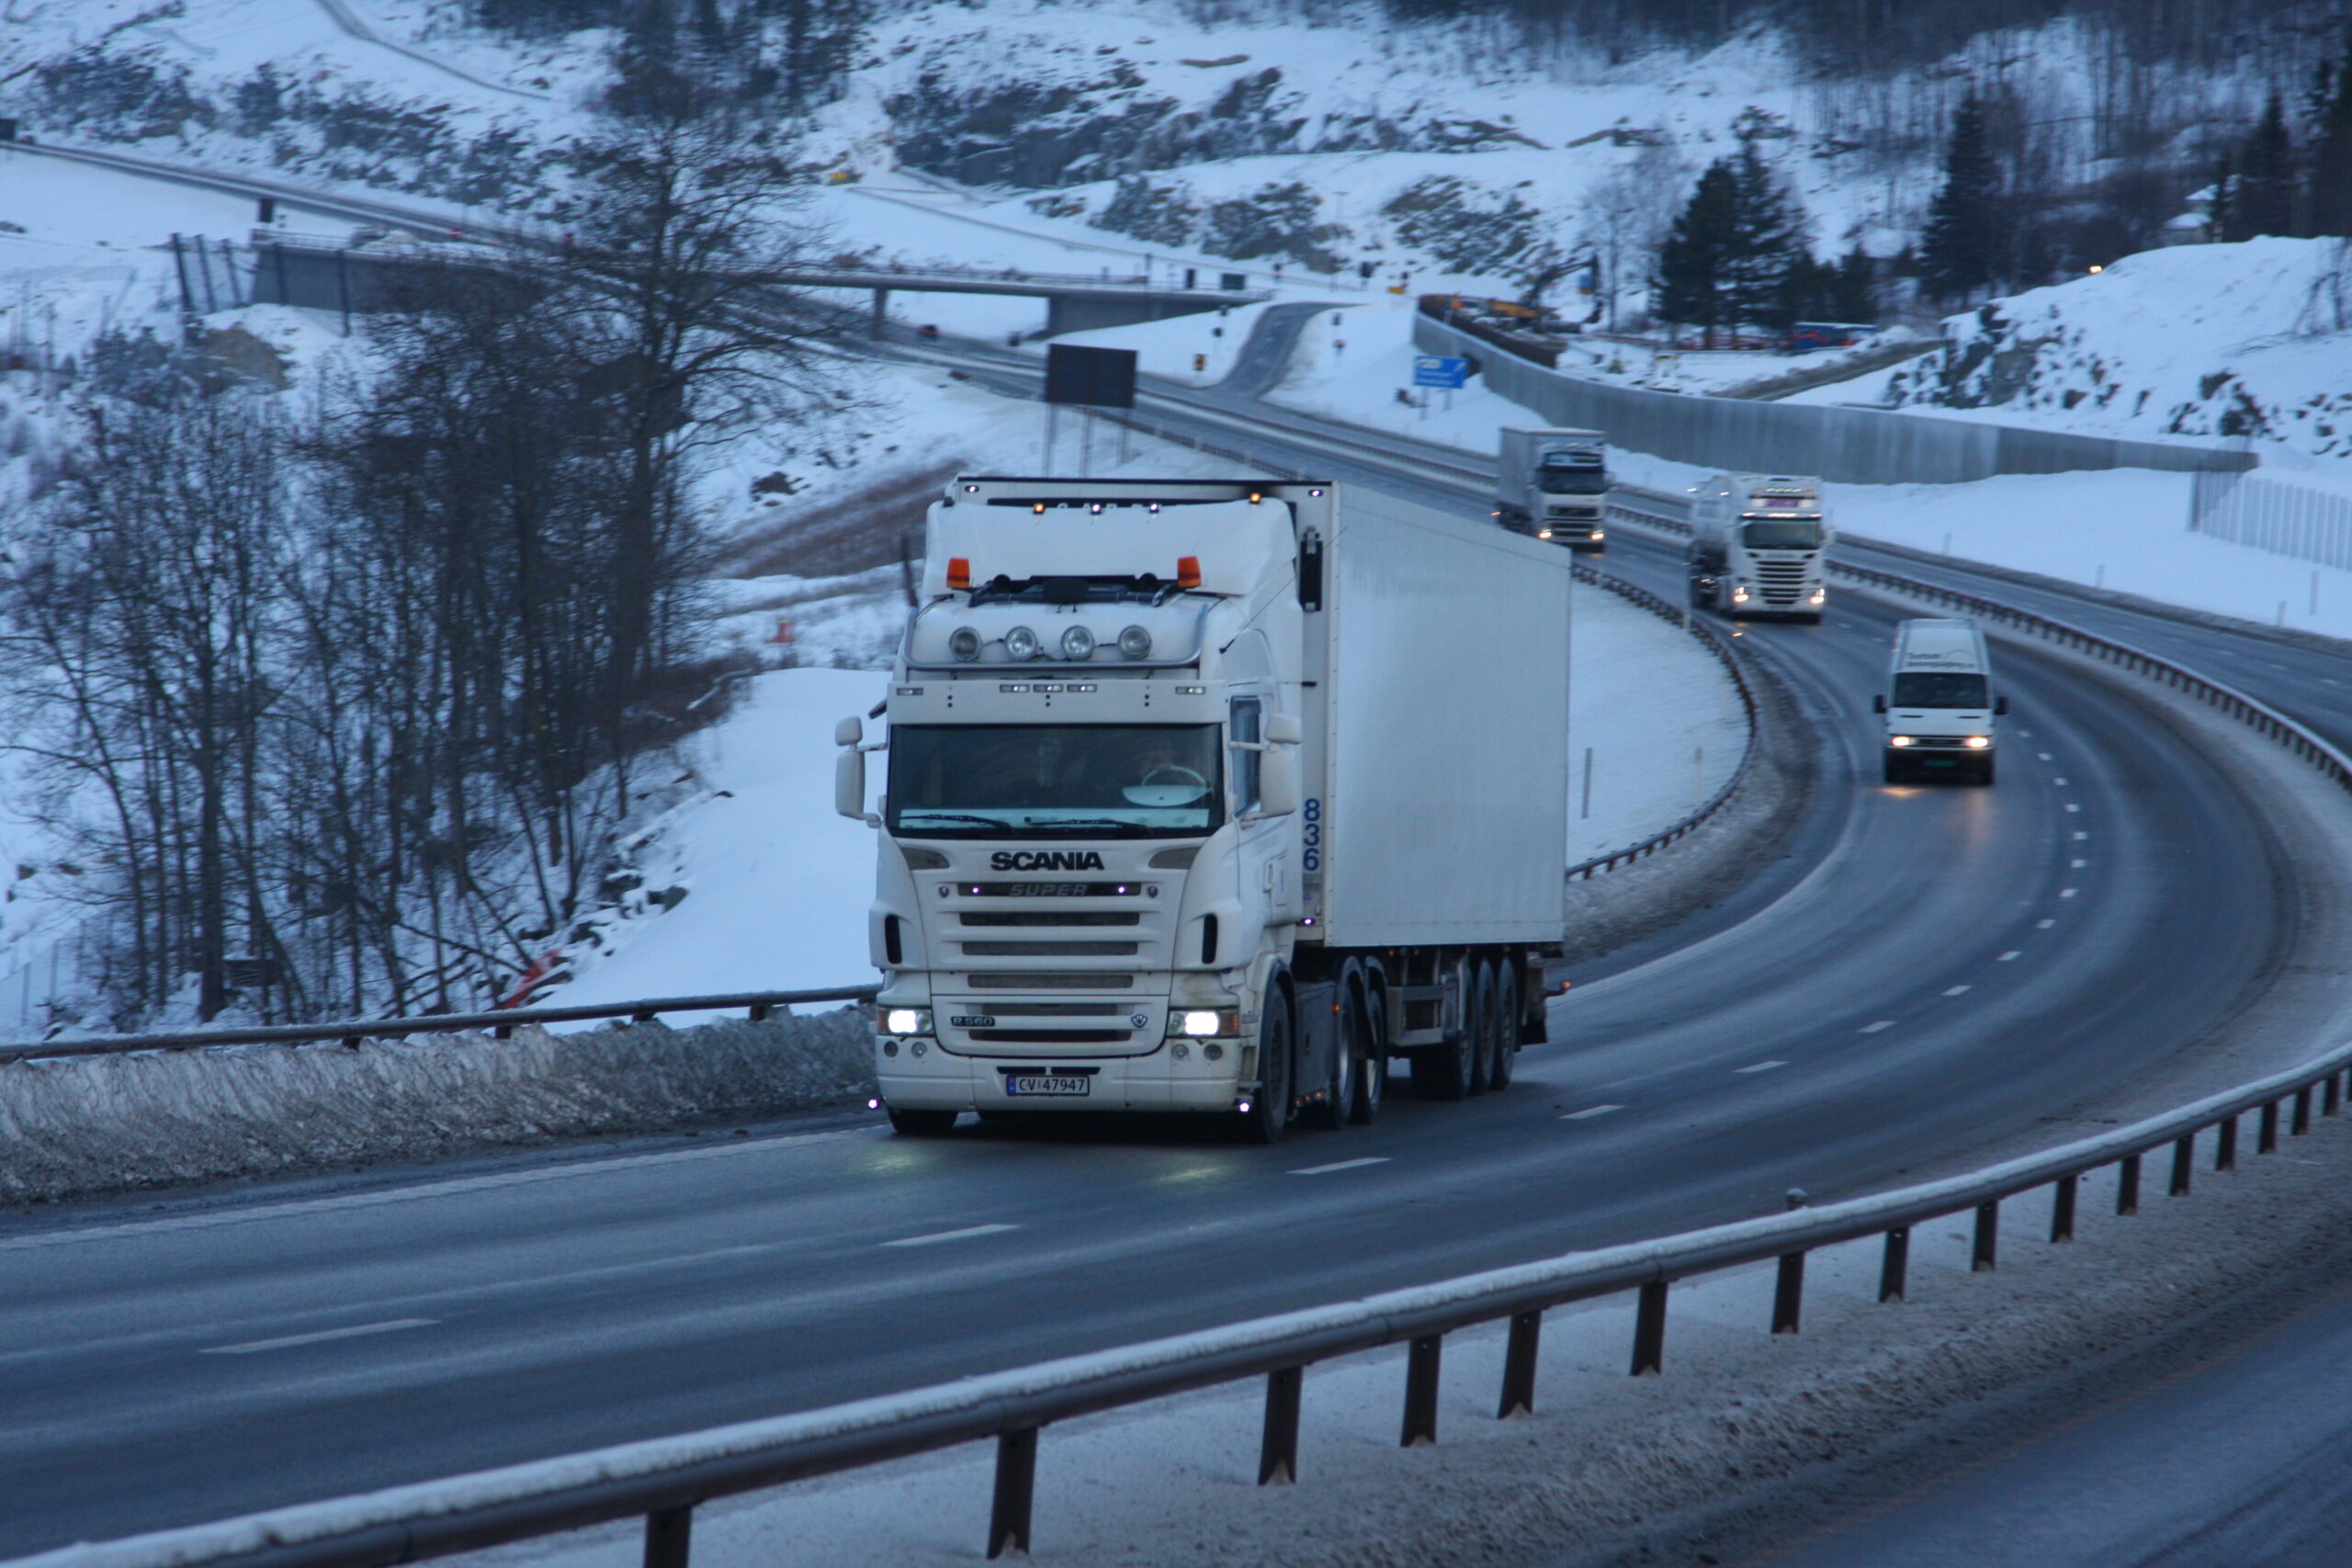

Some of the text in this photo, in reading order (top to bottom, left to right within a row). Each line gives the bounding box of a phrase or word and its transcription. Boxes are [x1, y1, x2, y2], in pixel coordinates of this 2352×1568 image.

[1303, 797, 1320, 871] 836
[990, 851, 1105, 871] SCANIA
[1011, 884, 1088, 897] SUPER
[954, 1017, 962, 1025] R
[1019, 1078, 1085, 1091] CV 47947
